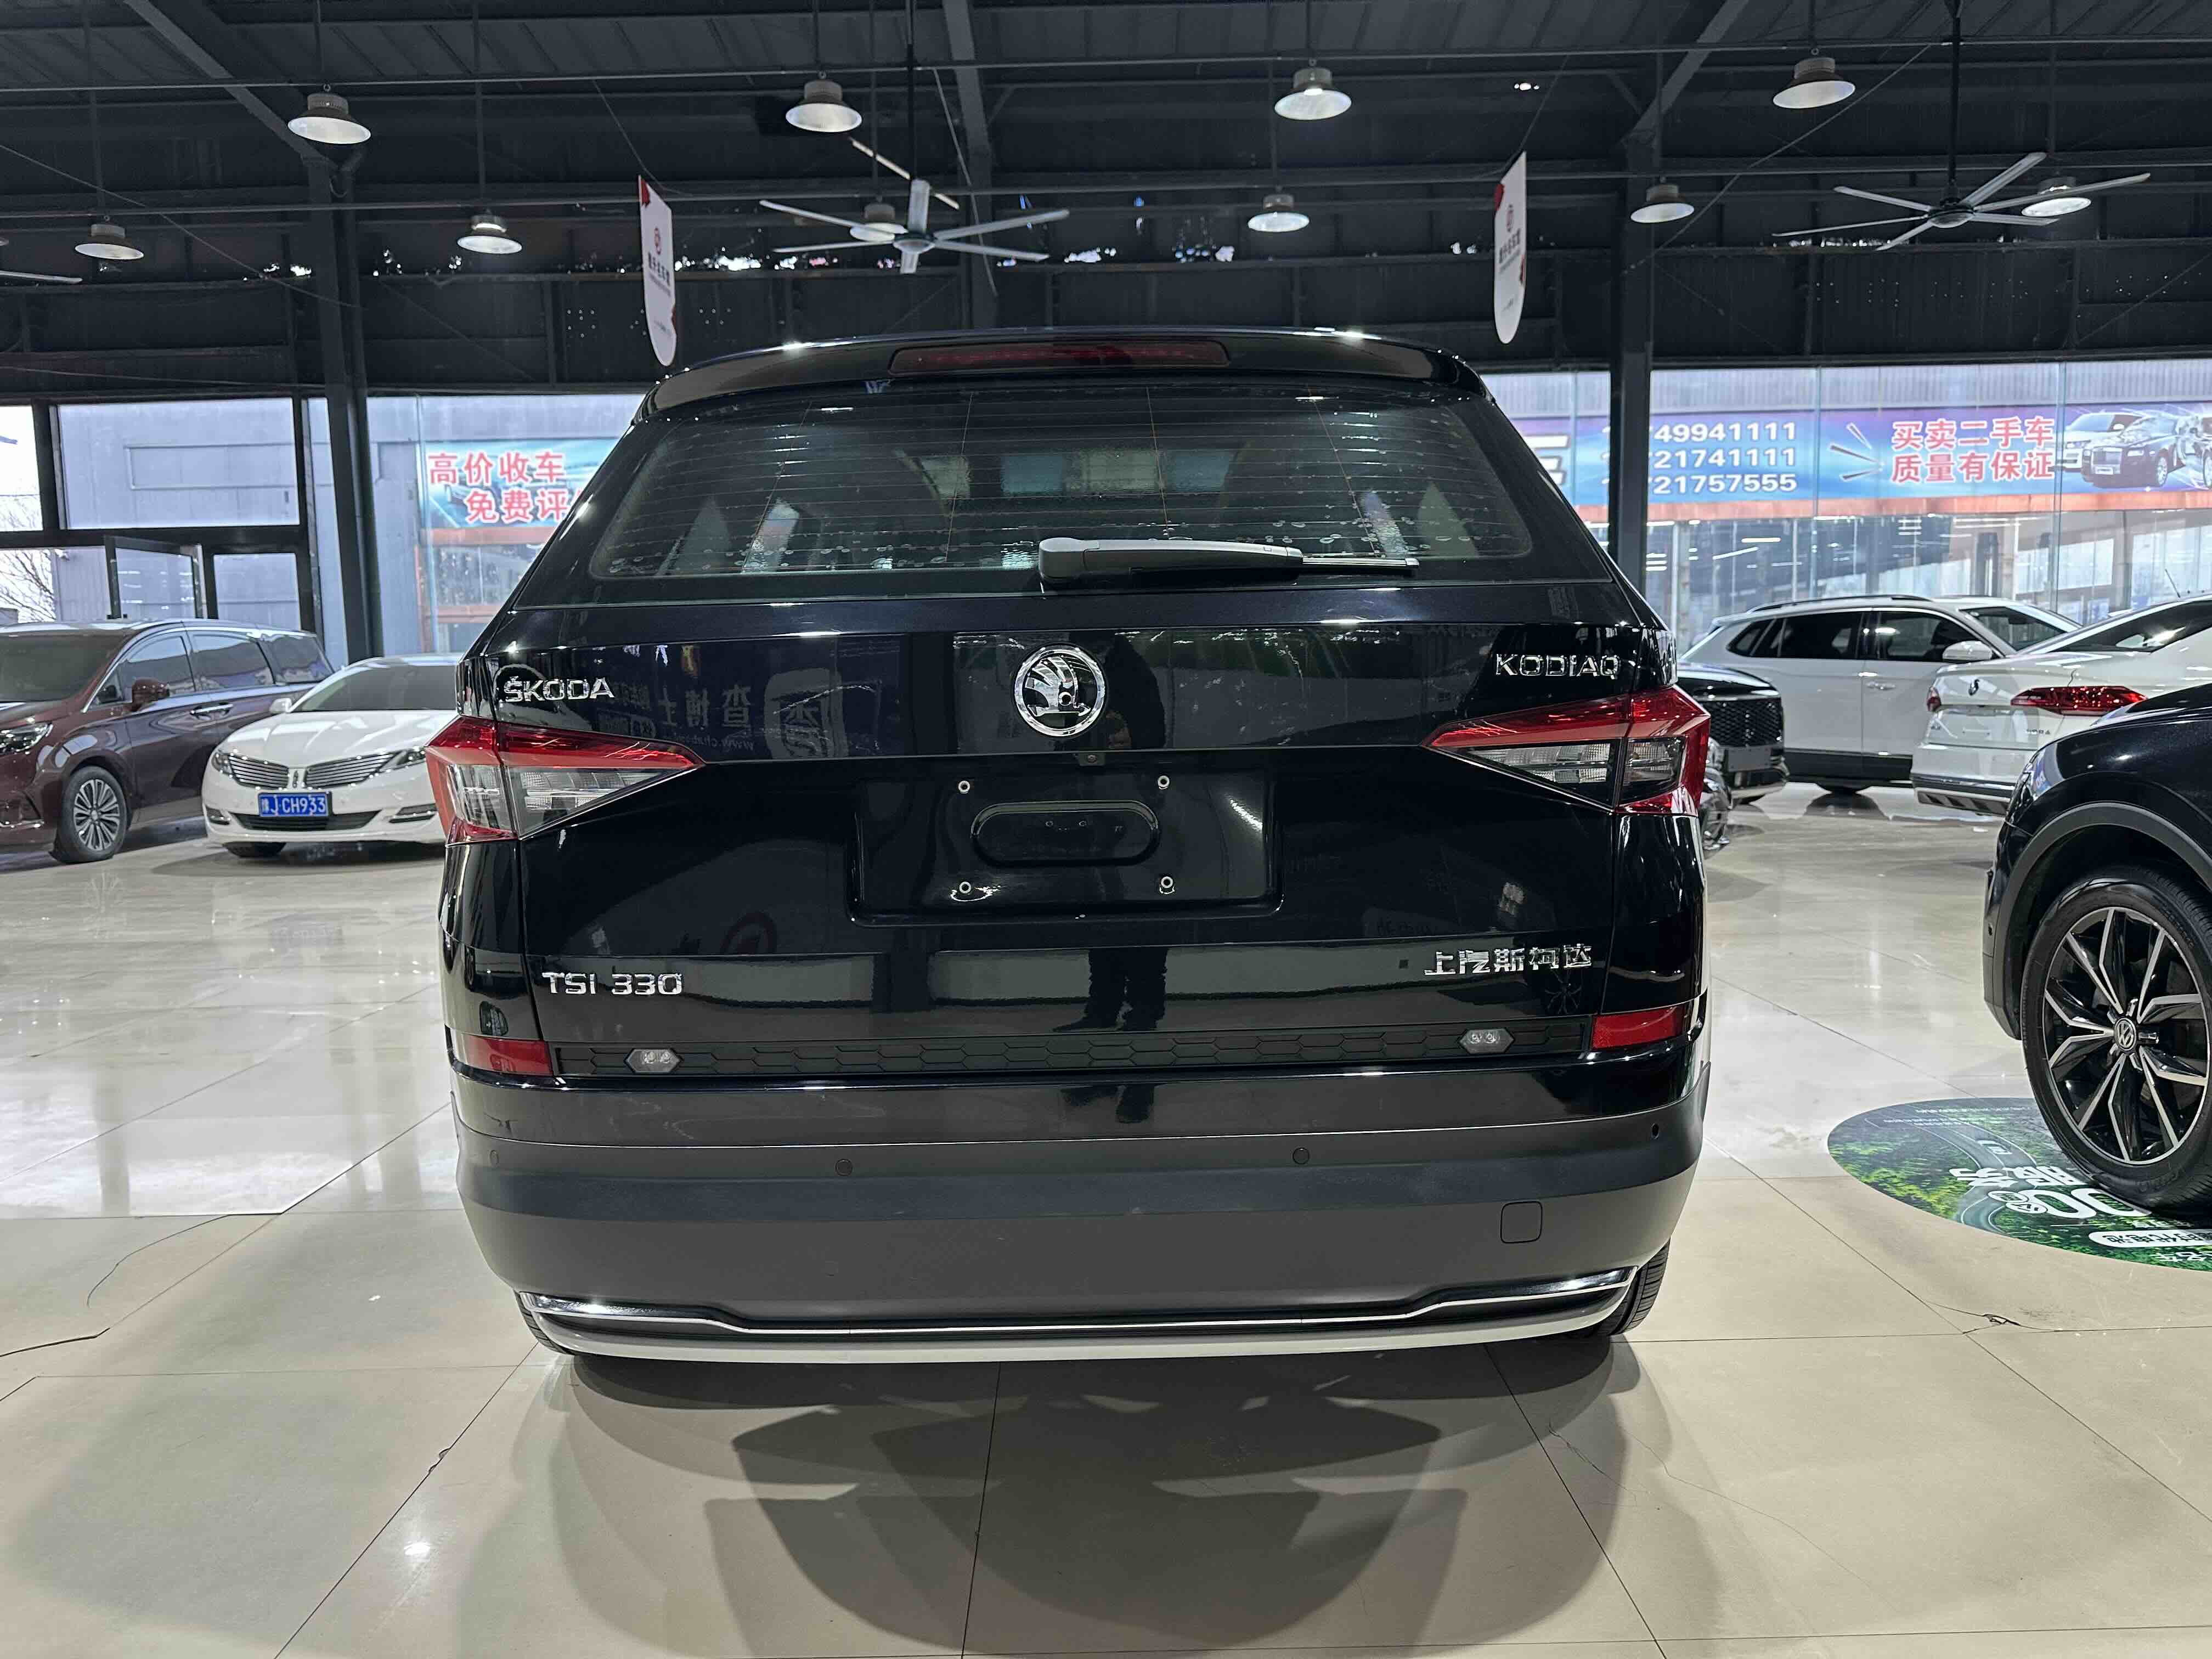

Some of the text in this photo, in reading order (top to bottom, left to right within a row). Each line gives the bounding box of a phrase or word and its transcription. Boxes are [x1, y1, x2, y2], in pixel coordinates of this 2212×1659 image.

[1602, 422, 1796, 443] 49941111
[1893, 417, 2053, 450] 买卖二手车
[427, 450, 564, 485] 高价收车
[1602, 448, 1795, 469] 21741111
[1892, 451, 2053, 483] 质量有保证
[1602, 473, 1797, 494] 21757555
[466, 488, 583, 522] 免费评
[1496, 653, 1620, 680] KODIAQ
[1424, 944, 1592, 975] 上汽斯柯达
[541, 972, 682, 995] TSI 330
